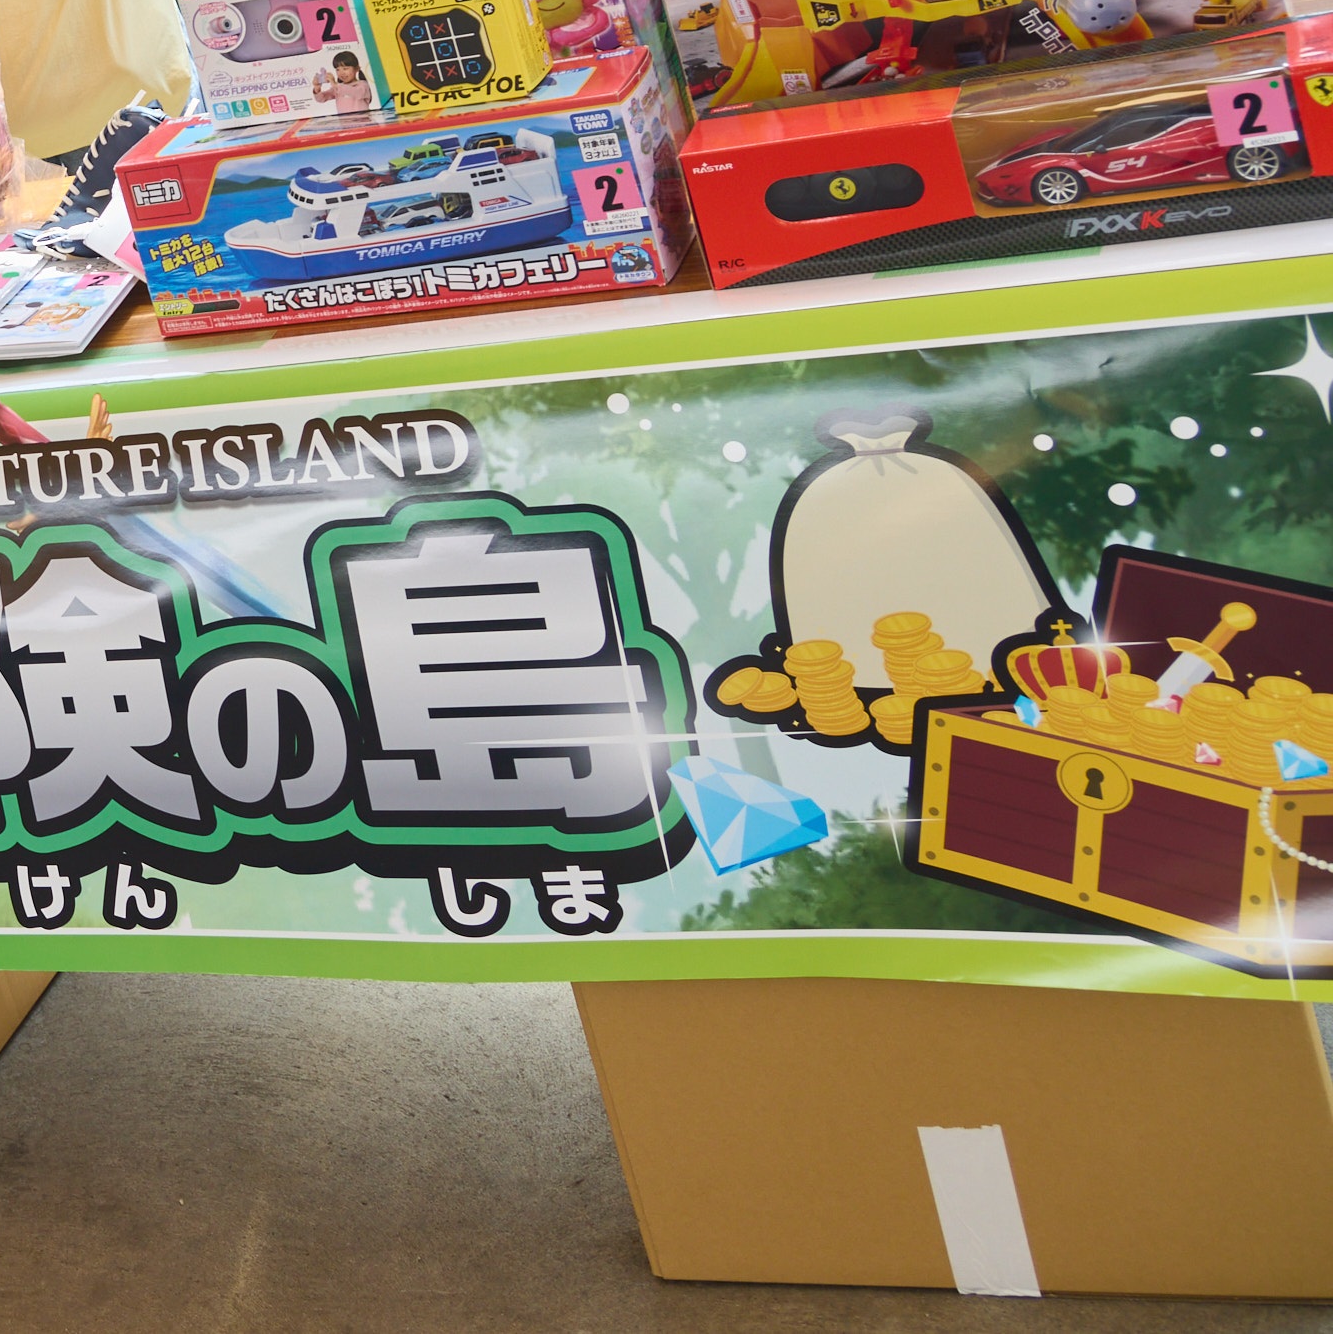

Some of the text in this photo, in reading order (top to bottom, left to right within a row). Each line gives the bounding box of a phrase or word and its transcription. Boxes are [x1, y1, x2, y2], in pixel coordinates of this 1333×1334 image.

[316, 7, 341, 42] 2
[210, 77, 308, 98] KIDS FLIPPING CAMERA
[573, 113, 608, 124] TAKARA
[574, 119, 609, 131] TOMY
[1233, 92, 1268, 135] 2
[692, 162, 734, 175] RASTAR
[1105, 155, 1147, 174] 54
[132, 179, 183, 207] トミカ
[594, 175, 623, 212] 2
[1068, 205, 1232, 239] FXX K EVO
[149, 233, 193, 261] トミカを
[356, 230, 487, 261] TOMICA FERRY
[718, 257, 746, 270] R/C
[88, 273, 111, 287] 2
[264, 265, 423, 313] たくさんはこぼう!
[422, 255, 607, 297] トミカフェリー
[183, 418, 472, 493] ISLAND
[436, 865, 614, 924] しま
